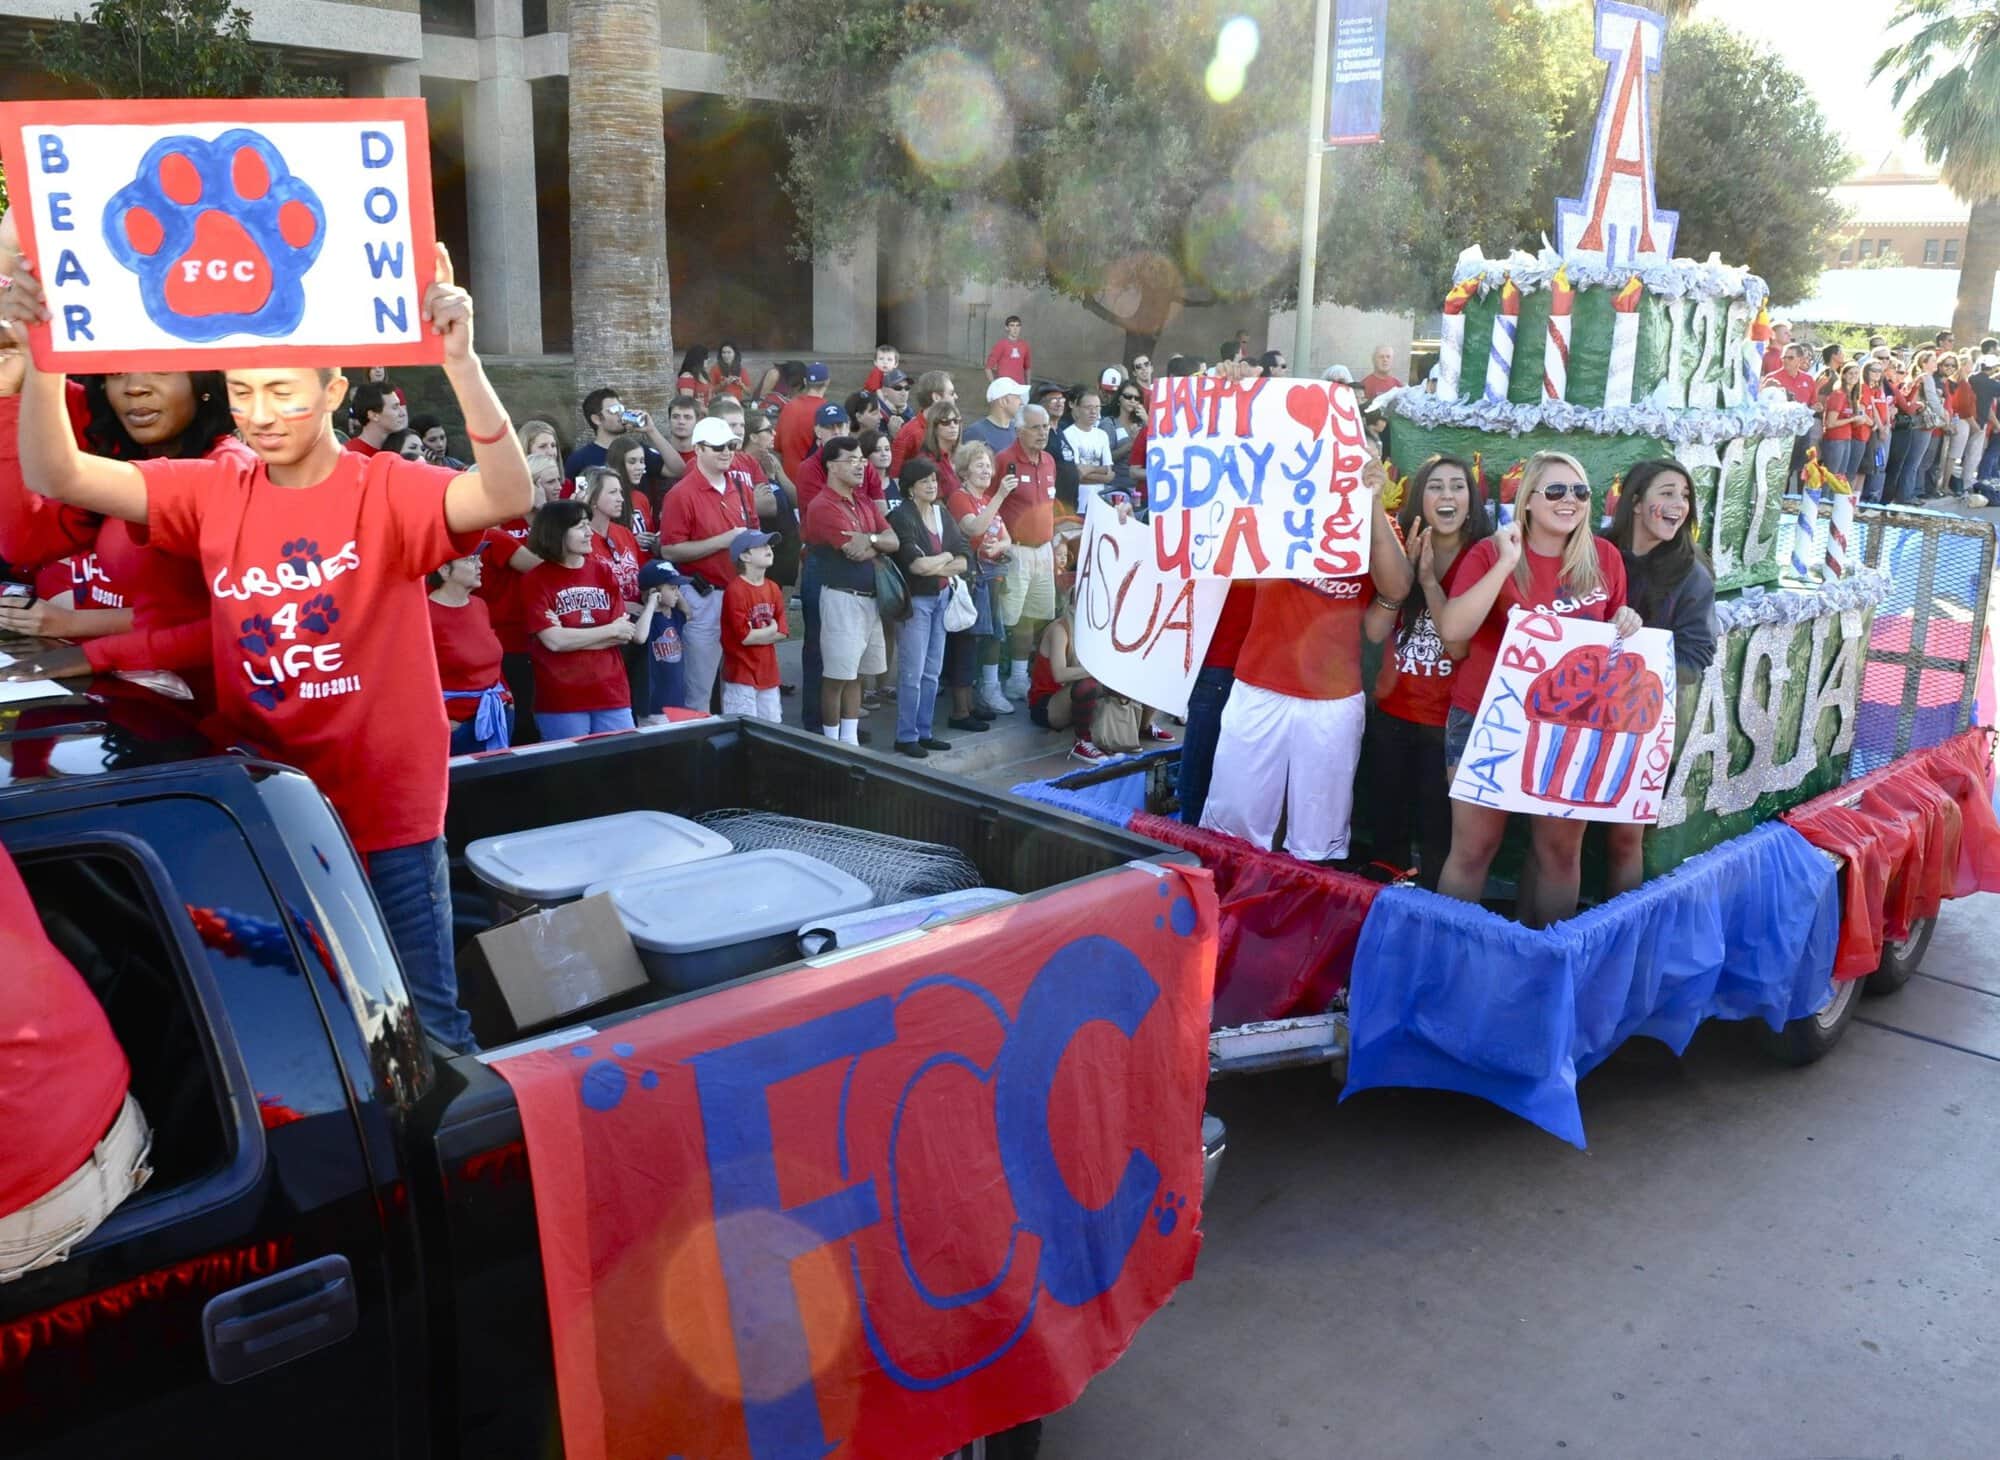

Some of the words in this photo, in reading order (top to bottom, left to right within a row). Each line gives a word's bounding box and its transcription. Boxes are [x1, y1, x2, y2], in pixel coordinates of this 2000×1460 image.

[38, 134, 95, 342] BEAR
[361, 130, 409, 334] DOWN
[182, 261, 256, 283] FCC
[1147, 376, 1271, 439] HAPPY
[212, 540, 361, 599] CUBBIES
[1154, 508, 1192, 580] U
[271, 602, 299, 639] 4
[1076, 527, 1197, 677] ASUA
[1508, 587, 1609, 619] BBIES
[243, 642, 344, 686] LIFE
[299, 674, 361, 699] 2010-2011
[1452, 675, 1524, 807] HAPPY
[1656, 609, 1863, 829] ASUA
[681, 933, 1162, 1460] FCC
